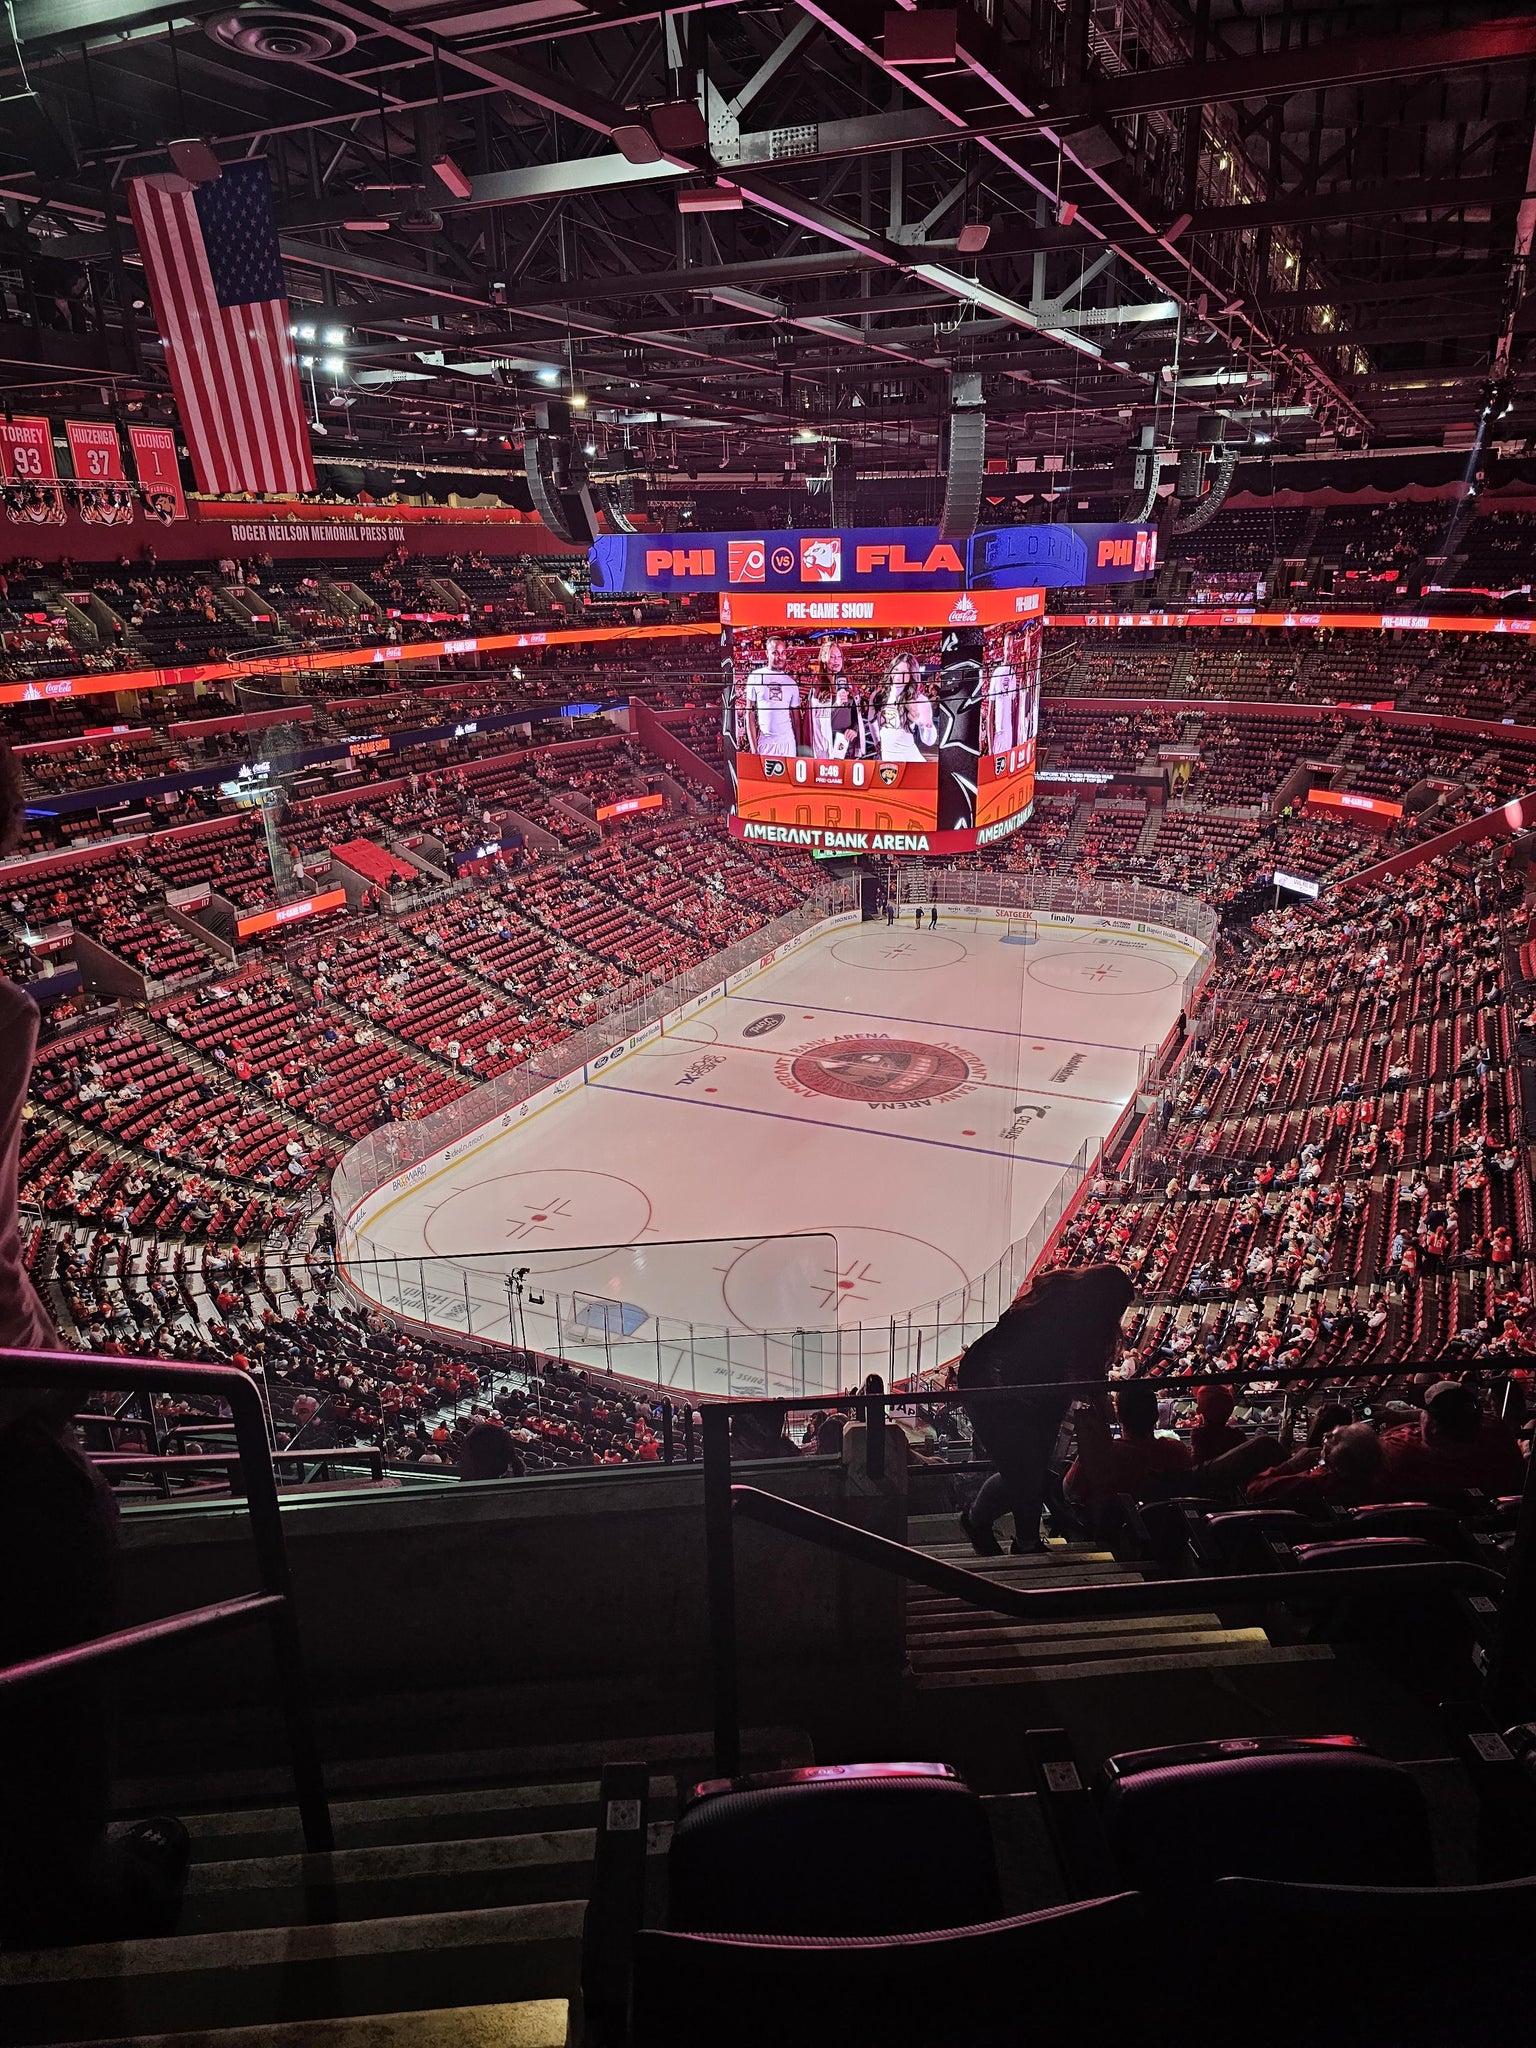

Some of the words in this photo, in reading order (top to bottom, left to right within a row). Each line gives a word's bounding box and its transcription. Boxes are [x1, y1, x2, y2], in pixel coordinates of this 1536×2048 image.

[2, 426, 44, 444] TORREY
[72, 428, 116, 446] HUIZENGA
[133, 432, 172, 449] LUONGO
[13, 447, 43, 475] 93
[87, 449, 109, 475] 37
[151, 451, 163, 476] 1
[149, 485, 174, 495] FLORIDA
[231, 524, 268, 542] ROGER
[268, 525, 310, 542] NEILSON
[310, 526, 360, 542] MEMORIAL
[360, 526, 388, 542] PRESS
[388, 526, 406, 542] BOX
[775, 554, 791, 566] VS
[856, 544, 964, 573] FLA
[1097, 539, 1134, 567] PHI
[646, 549, 716, 576] PHI
[786, 602, 840, 619] PRE-GAME
[841, 602, 874, 619] SHOW
[948, 609, 979, 623] Coca-Cola
[45, 680, 73, 695] Coca-Cola
[795, 759, 807, 784] 0
[852, 762, 865, 786] 0
[815, 777, 843, 785] PRE-GAME
[743, 823, 822, 846] AMERANT
[824, 833, 869, 850] BANK
[871, 834, 930, 851] ARENA
[976, 816, 1016, 846] AMERANT
[200, 898, 210, 907] 117
[834, 914, 858, 925] HONDA
[995, 909, 1033, 919] SEATGEEK
[1050, 913, 1075, 924] finally
[61, 937, 73, 946] 116
[760, 951, 776, 970] DEX
[749, 1016, 779, 1034] Ford
[450, 1046, 457, 1054] 19
[789, 1037, 828, 1054] BANK
[833, 1032, 891, 1042] ARENA
[934, 1041, 988, 1082] AMERANT
[774, 1057, 819, 1099] AMERANT
[888, 1056, 933, 1091] PANTHERS
[938, 1084, 979, 1104] BANK
[868, 1098, 932, 1111] ARENA
[1004, 1115, 1033, 1140] CELSIUS
[1433, 1238, 1442, 1248] 16
